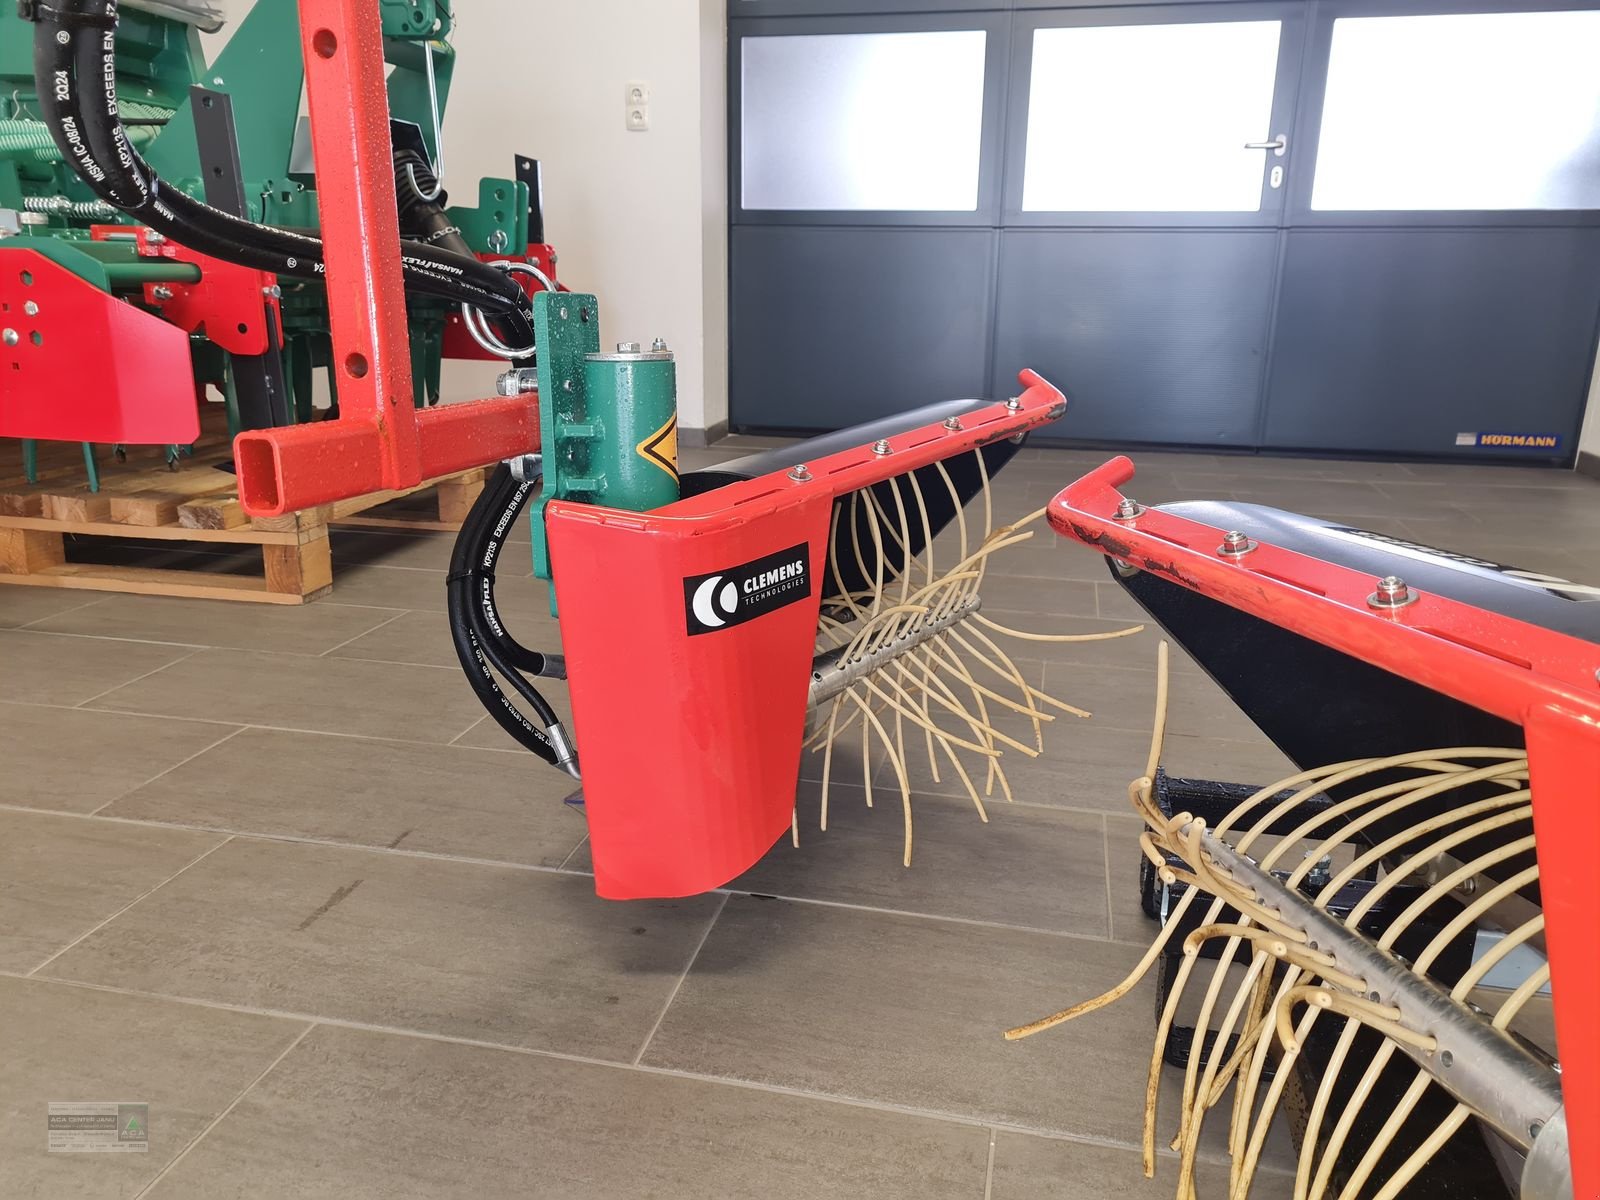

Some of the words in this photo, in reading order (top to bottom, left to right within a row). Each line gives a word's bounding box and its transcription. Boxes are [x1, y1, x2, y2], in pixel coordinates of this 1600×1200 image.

[103, 30, 114, 50] EN
[55, 70, 70, 101] 2Q24
[103, 53, 118, 116] EXCEEDS
[112, 126, 132, 168] KP213S
[80, 154, 106, 182] MSHA
[483, 540, 497, 567] KP213S
[493, 508, 514, 538] EXCEEDS
[508, 501, 518, 511] EN
[743, 560, 804, 594] CLEMENS
[745, 577, 805, 606] TECHNOLOGIES
